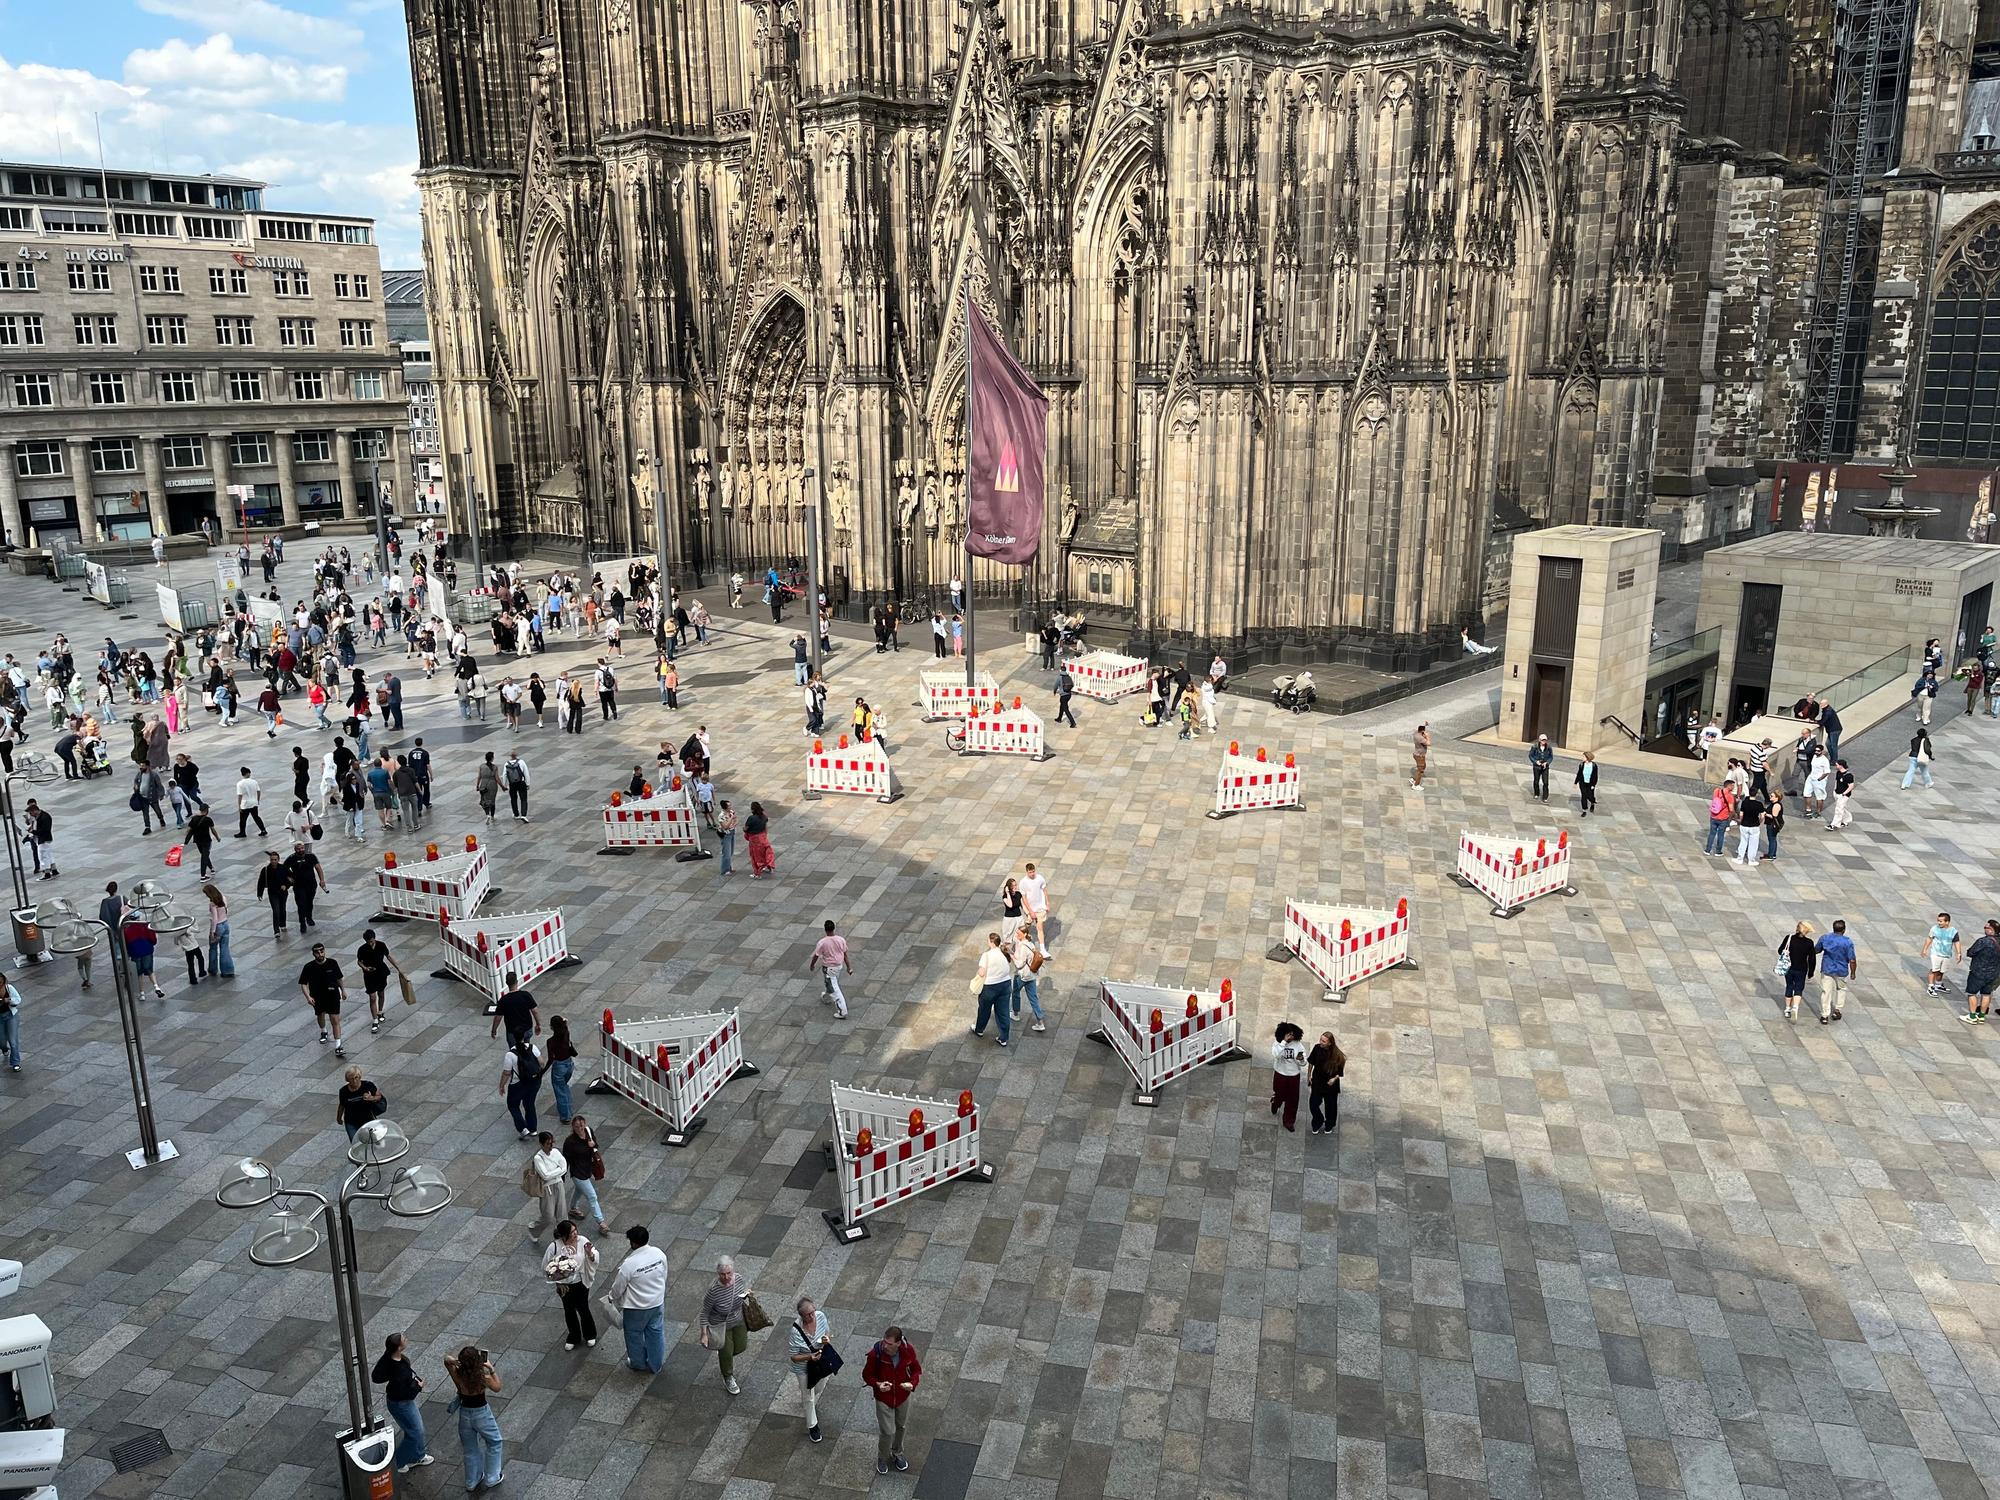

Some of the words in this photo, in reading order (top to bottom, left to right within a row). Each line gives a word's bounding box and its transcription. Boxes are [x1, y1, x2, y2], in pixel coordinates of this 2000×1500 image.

[65, 248, 80, 261] in
[87, 248, 124, 262] Köln
[255, 256, 302, 269] SATURN
[4, 1466, 51, 1475] PANOMERA
